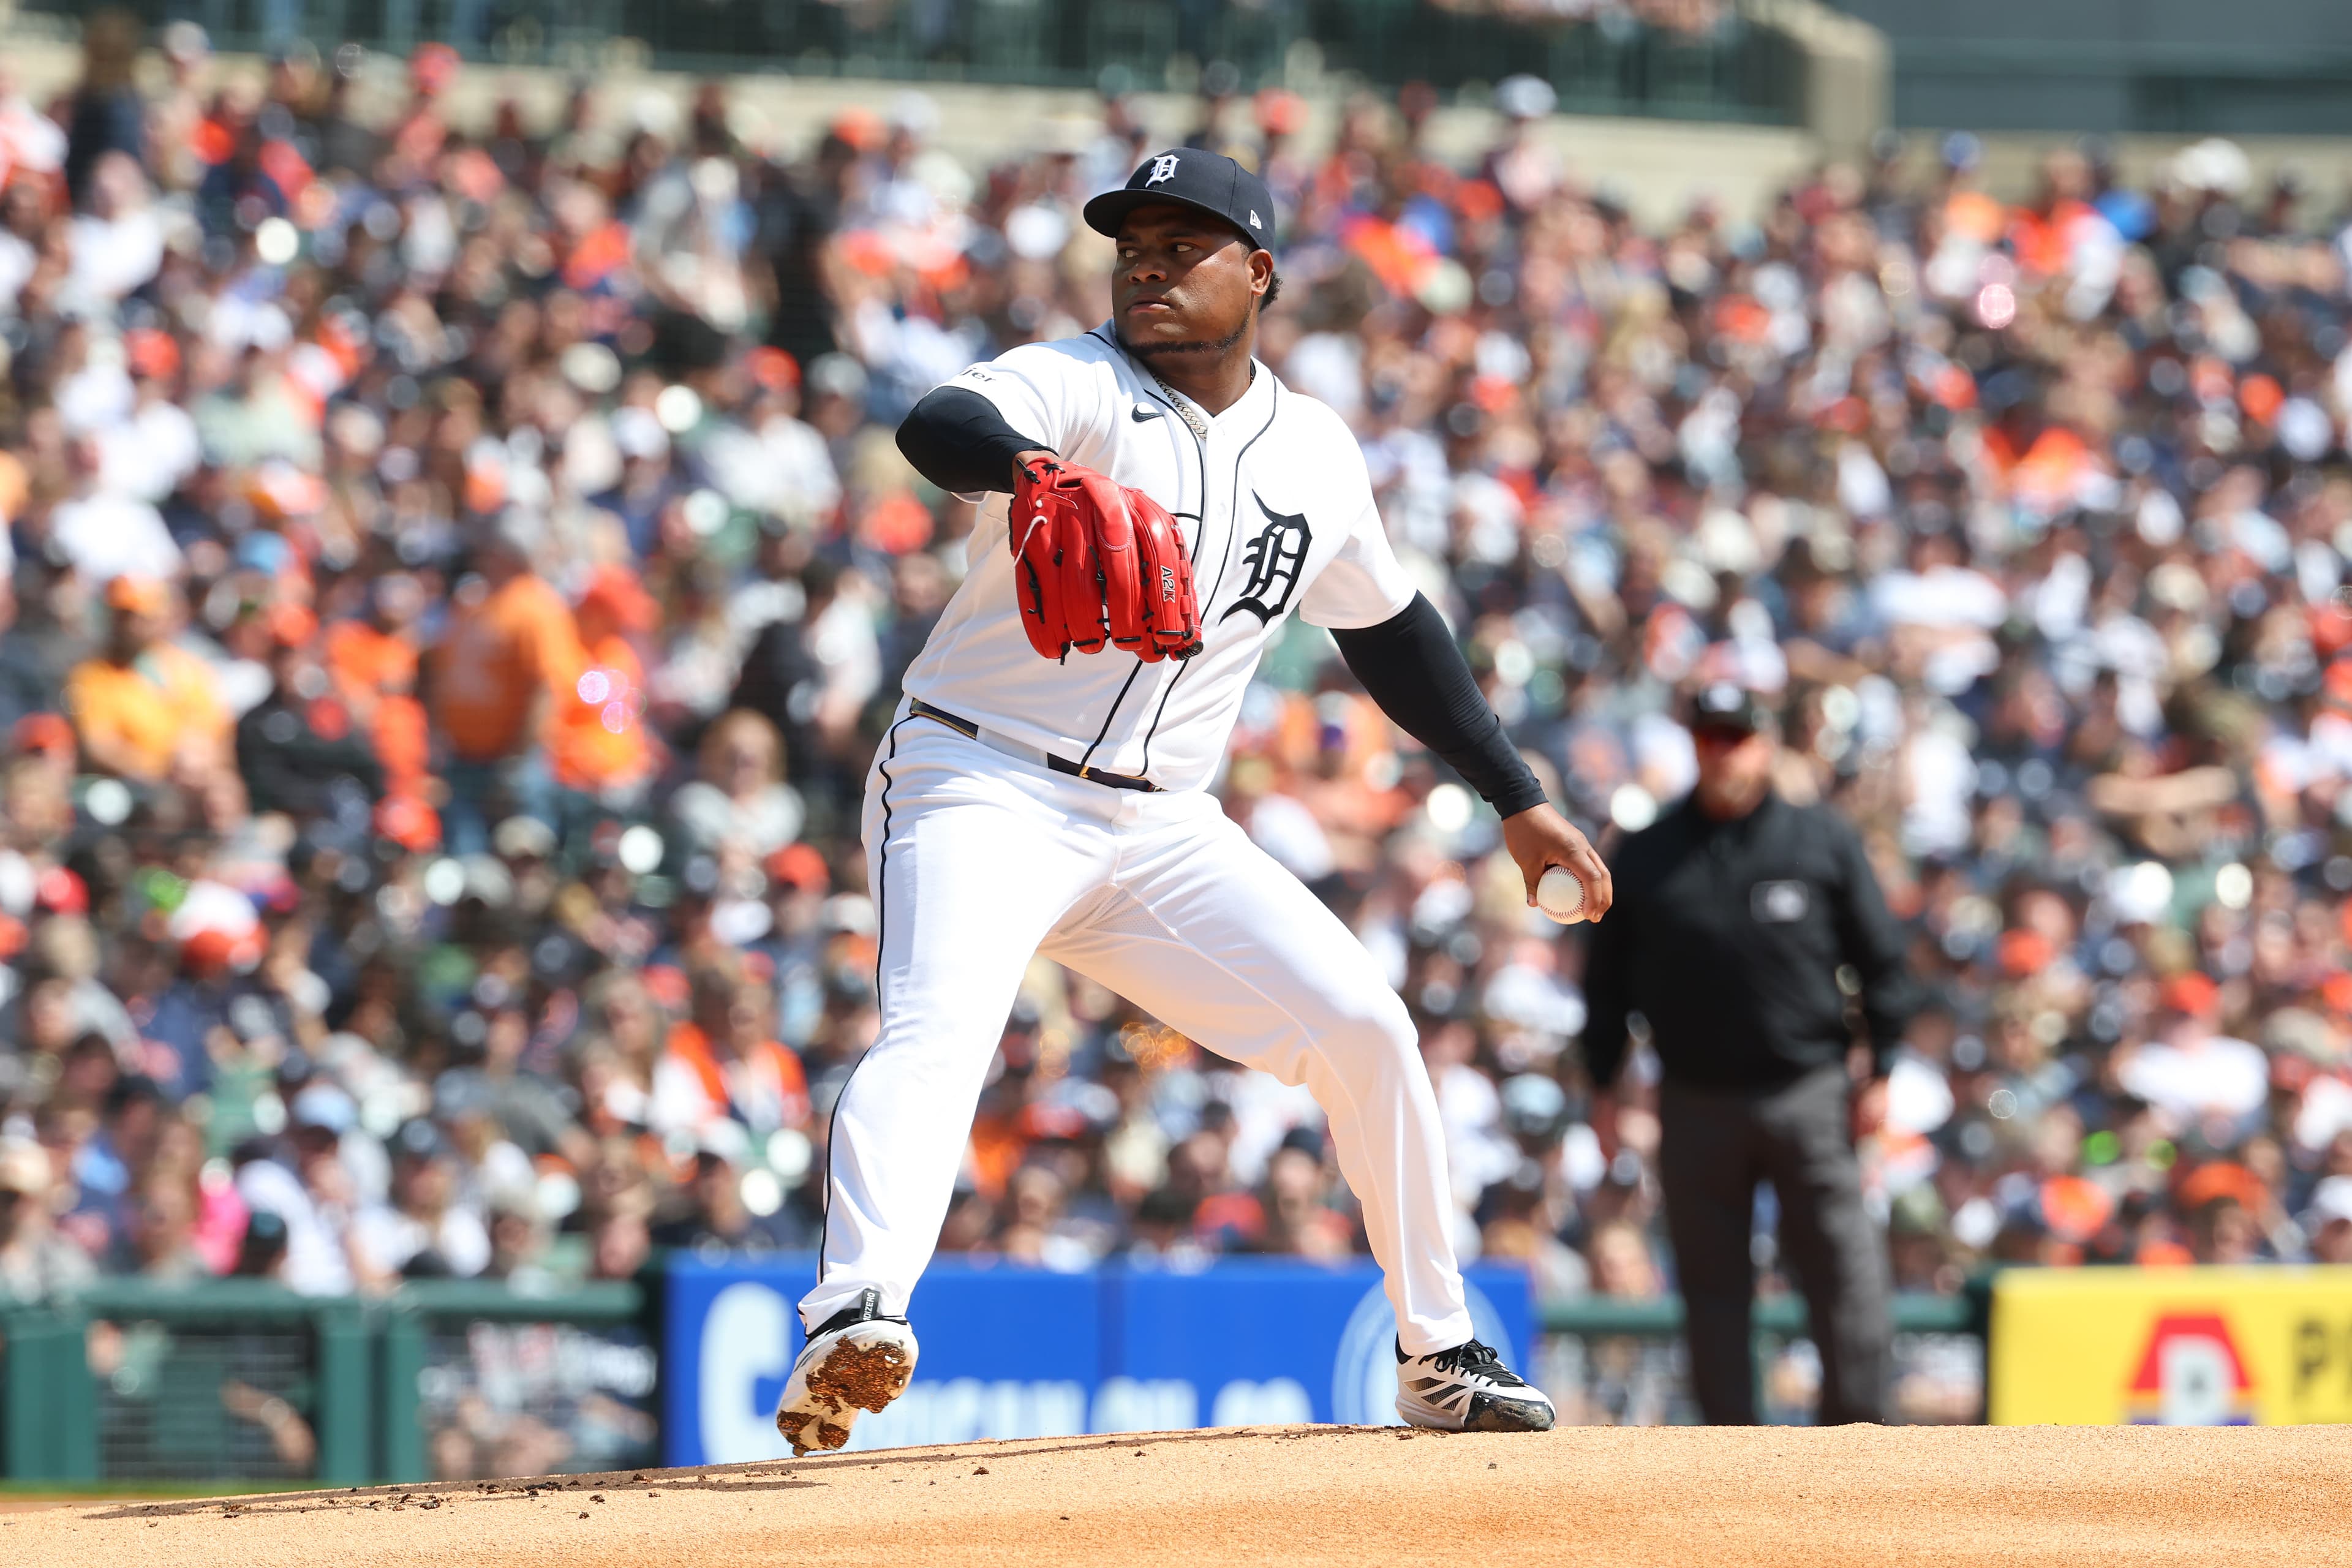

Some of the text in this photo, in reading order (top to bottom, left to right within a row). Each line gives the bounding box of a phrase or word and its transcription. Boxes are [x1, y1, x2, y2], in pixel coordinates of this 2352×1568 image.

[1145, 154, 1180, 187] D
[1218, 488, 1313, 628] D
[1160, 565, 1176, 603] A2K
